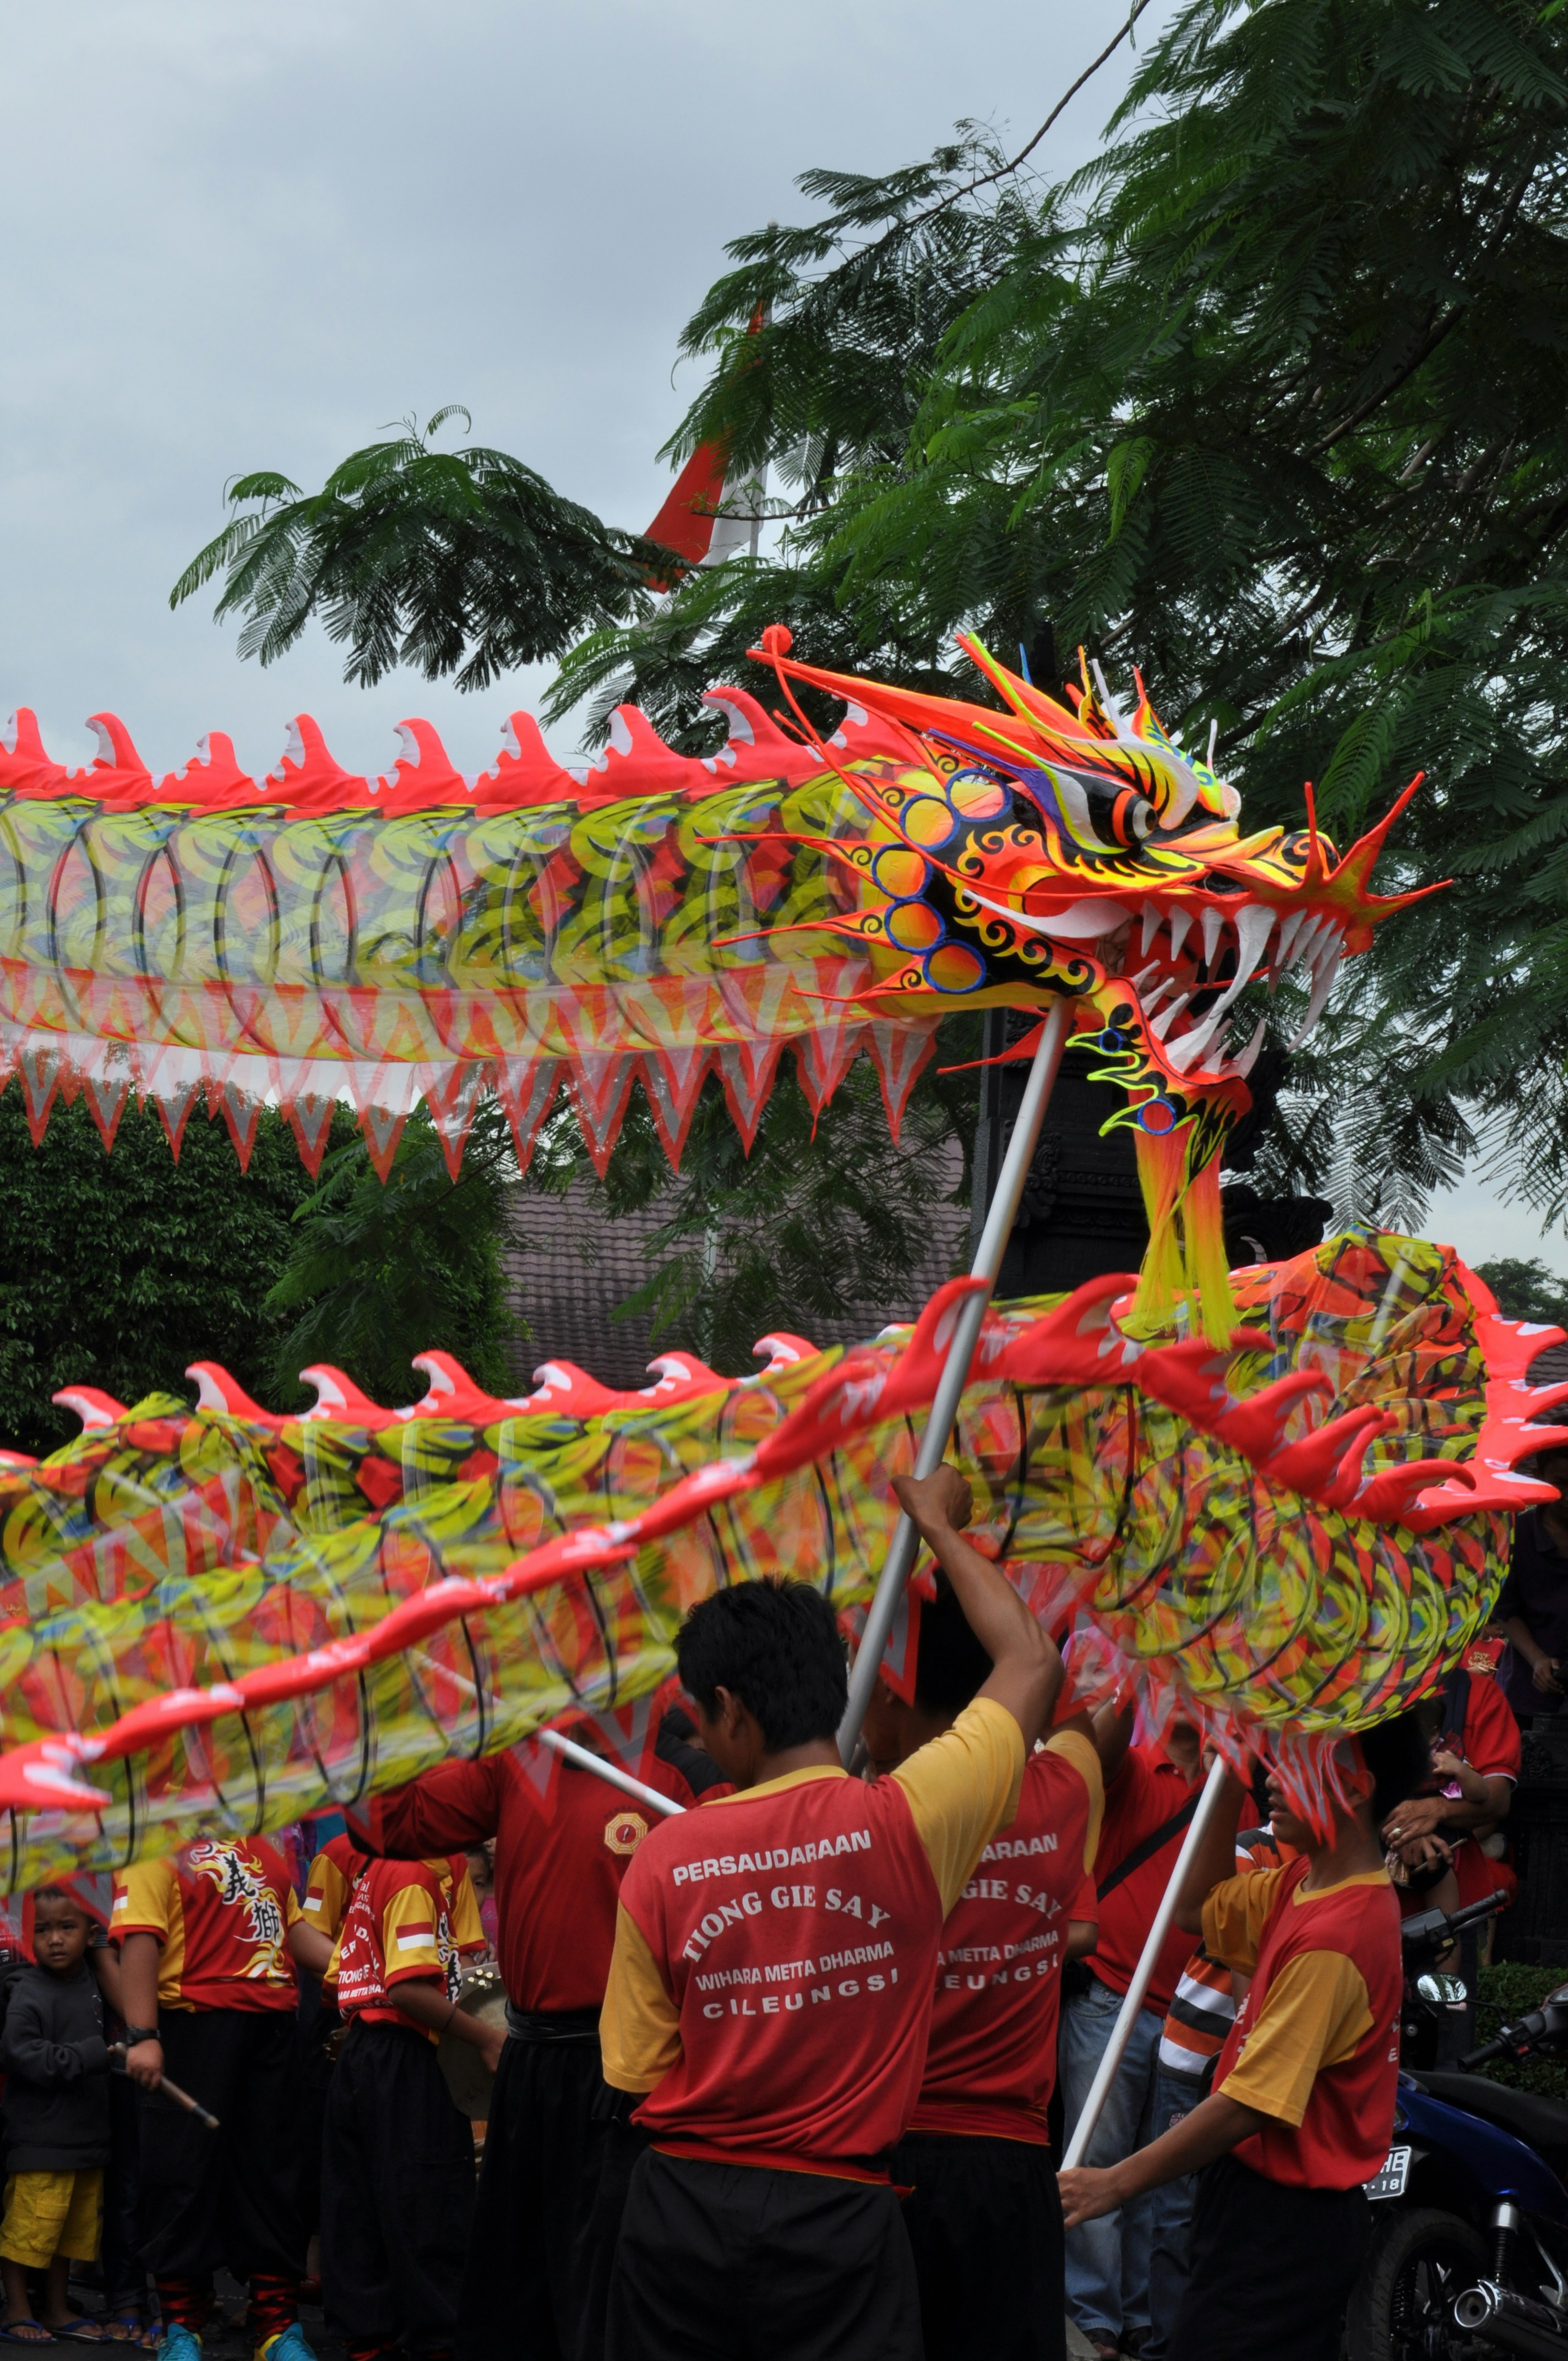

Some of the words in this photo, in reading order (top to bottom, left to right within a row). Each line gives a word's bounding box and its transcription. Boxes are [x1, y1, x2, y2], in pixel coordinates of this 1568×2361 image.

[673, 1830, 872, 1886] PERSAUDARAAN
[682, 1892, 763, 1963] TIONG
[771, 1885, 816, 1909] GIE
[825, 1888, 891, 1928] SAY
[960, 1879, 1009, 1900] GIE
[1014, 1884, 1063, 1920] SAY
[695, 1967, 763, 1991] WIHARA
[764, 1959, 816, 1982] METTA
[819, 1941, 895, 1973] DHARMA
[948, 1946, 1001, 1963] METTA
[1003, 1930, 1059, 1960] DHARMA
[703, 1968, 899, 2019] CILEUNGSI
[944, 1954, 1059, 1990] EUNGSI
